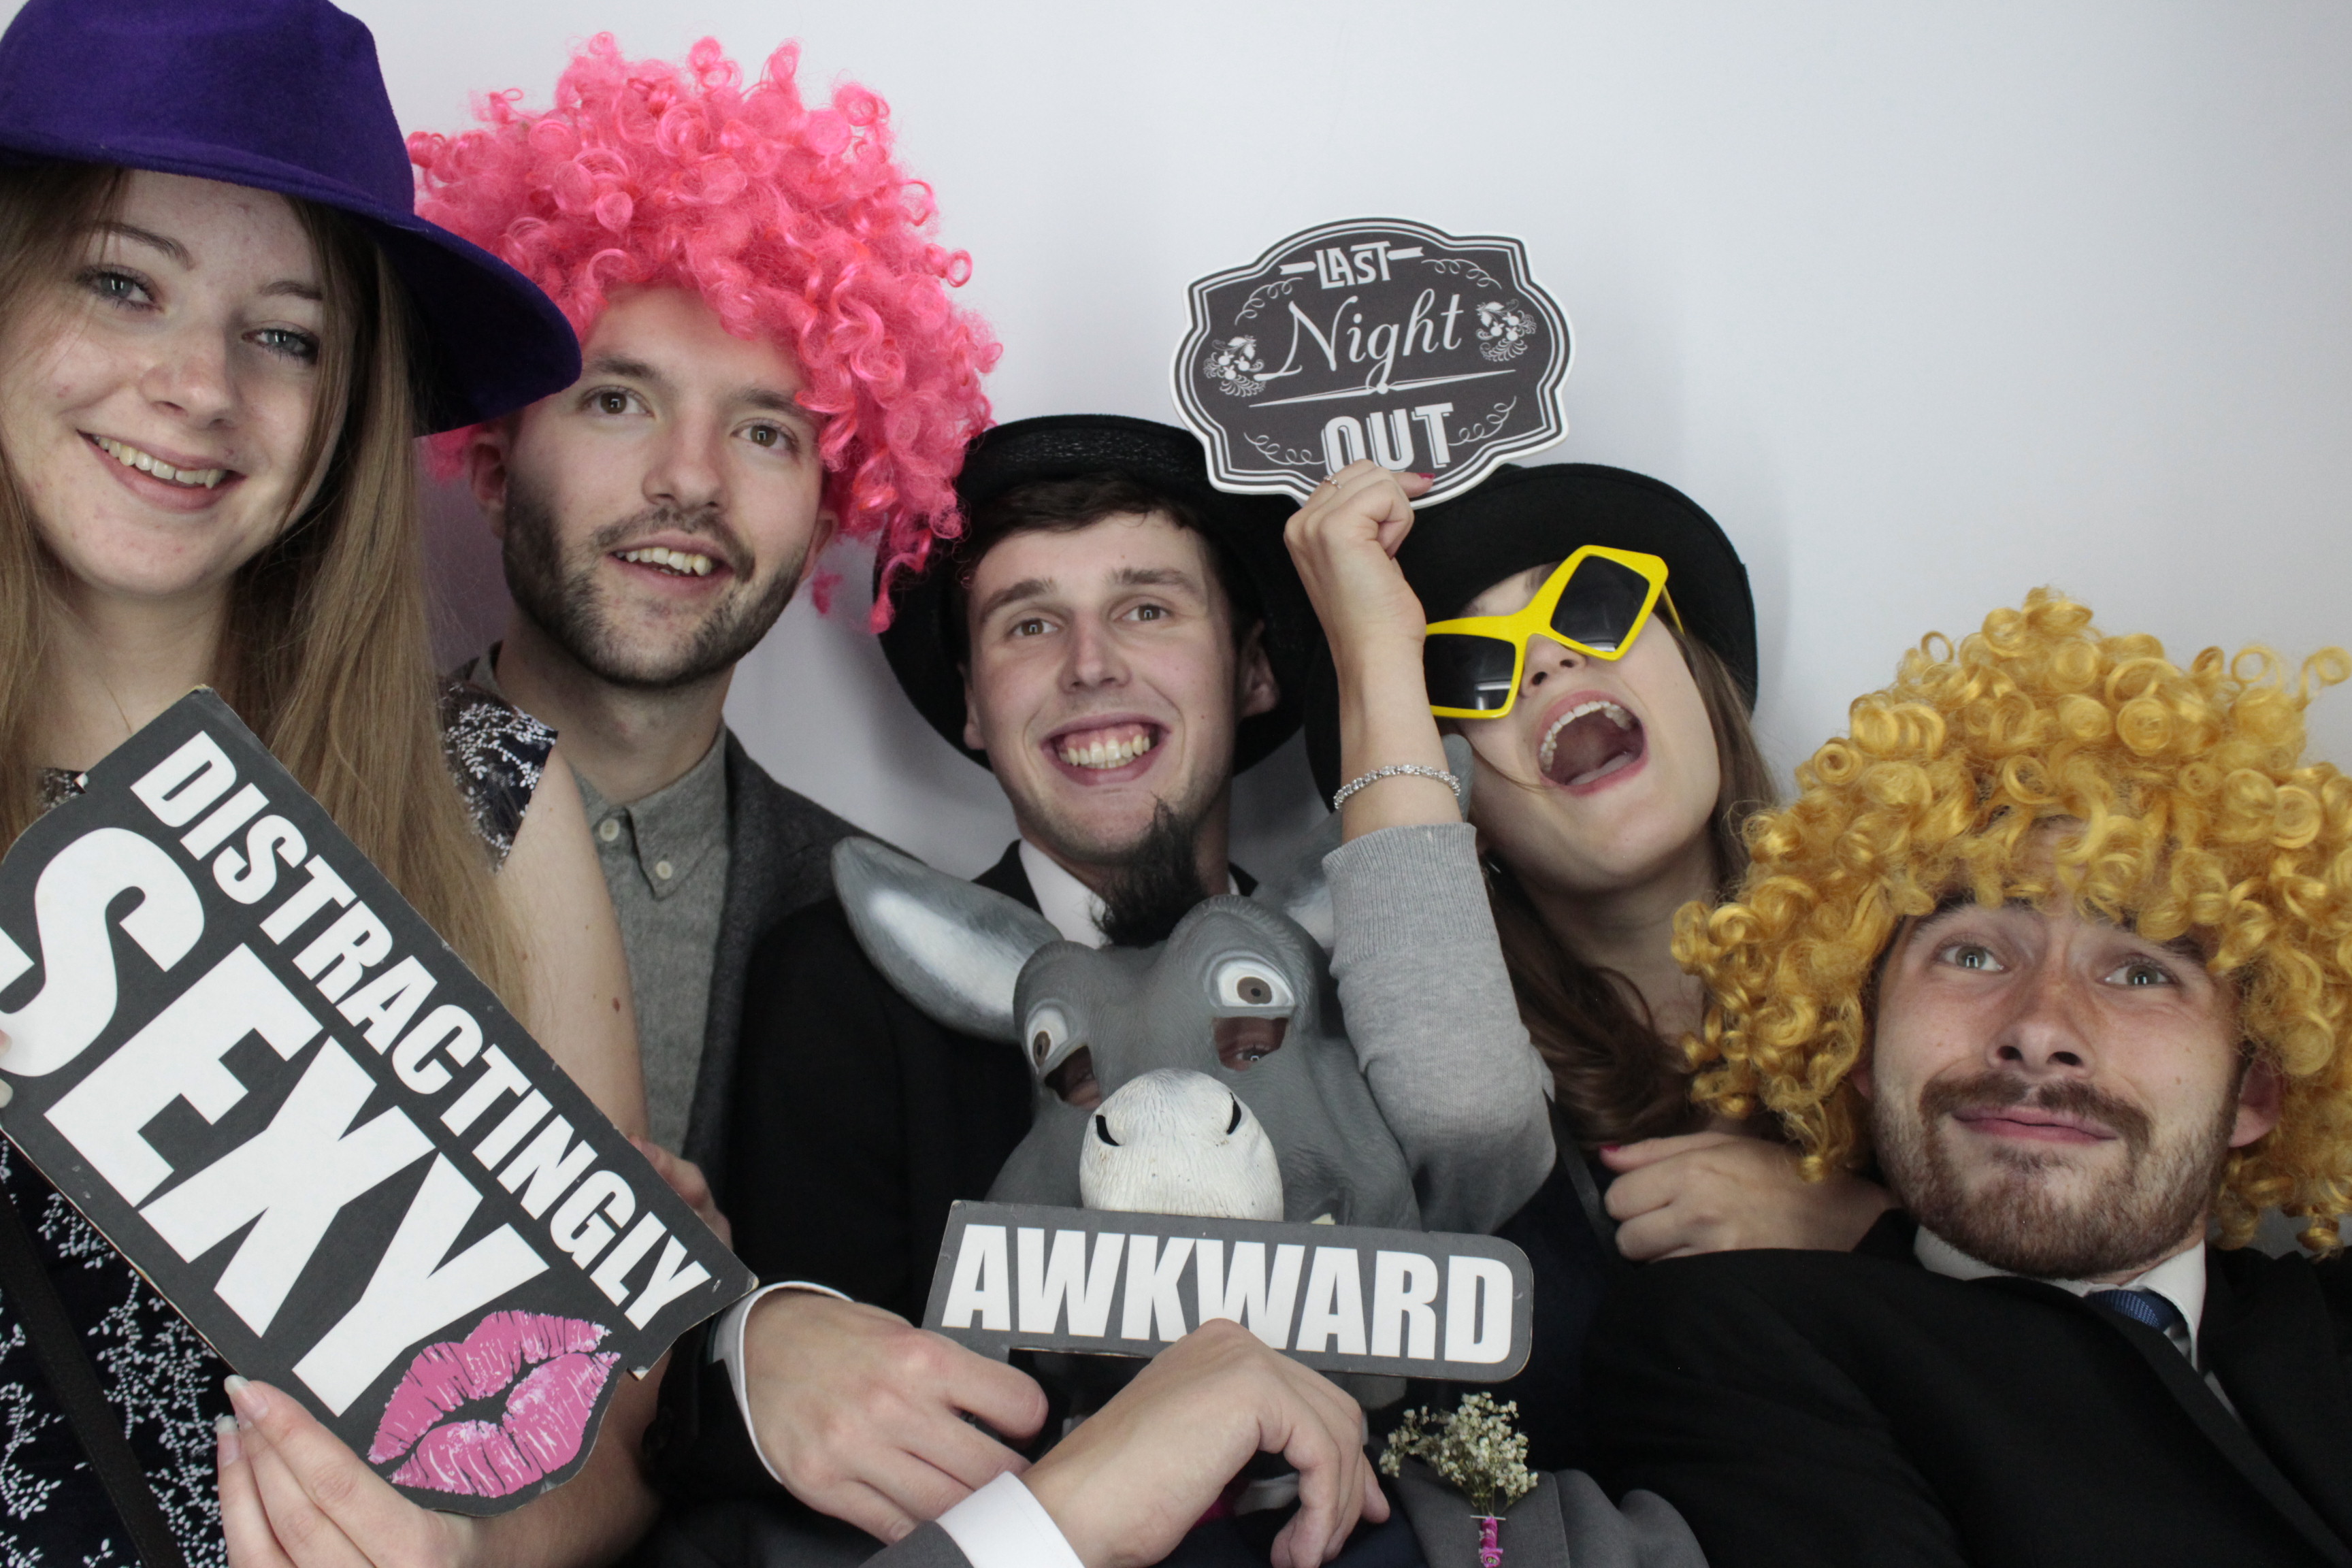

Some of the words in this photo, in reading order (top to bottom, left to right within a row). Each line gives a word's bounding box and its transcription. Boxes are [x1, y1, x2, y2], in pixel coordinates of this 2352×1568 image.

[1314, 241, 1391, 289] LAST
[1254, 288, 1464, 393] Night
[1322, 402, 1454, 476] OUT
[130, 730, 712, 1330] DISTRACTINGLY
[0, 826, 550, 1418] SEXY
[942, 1224, 1513, 1364] AWKWARD
